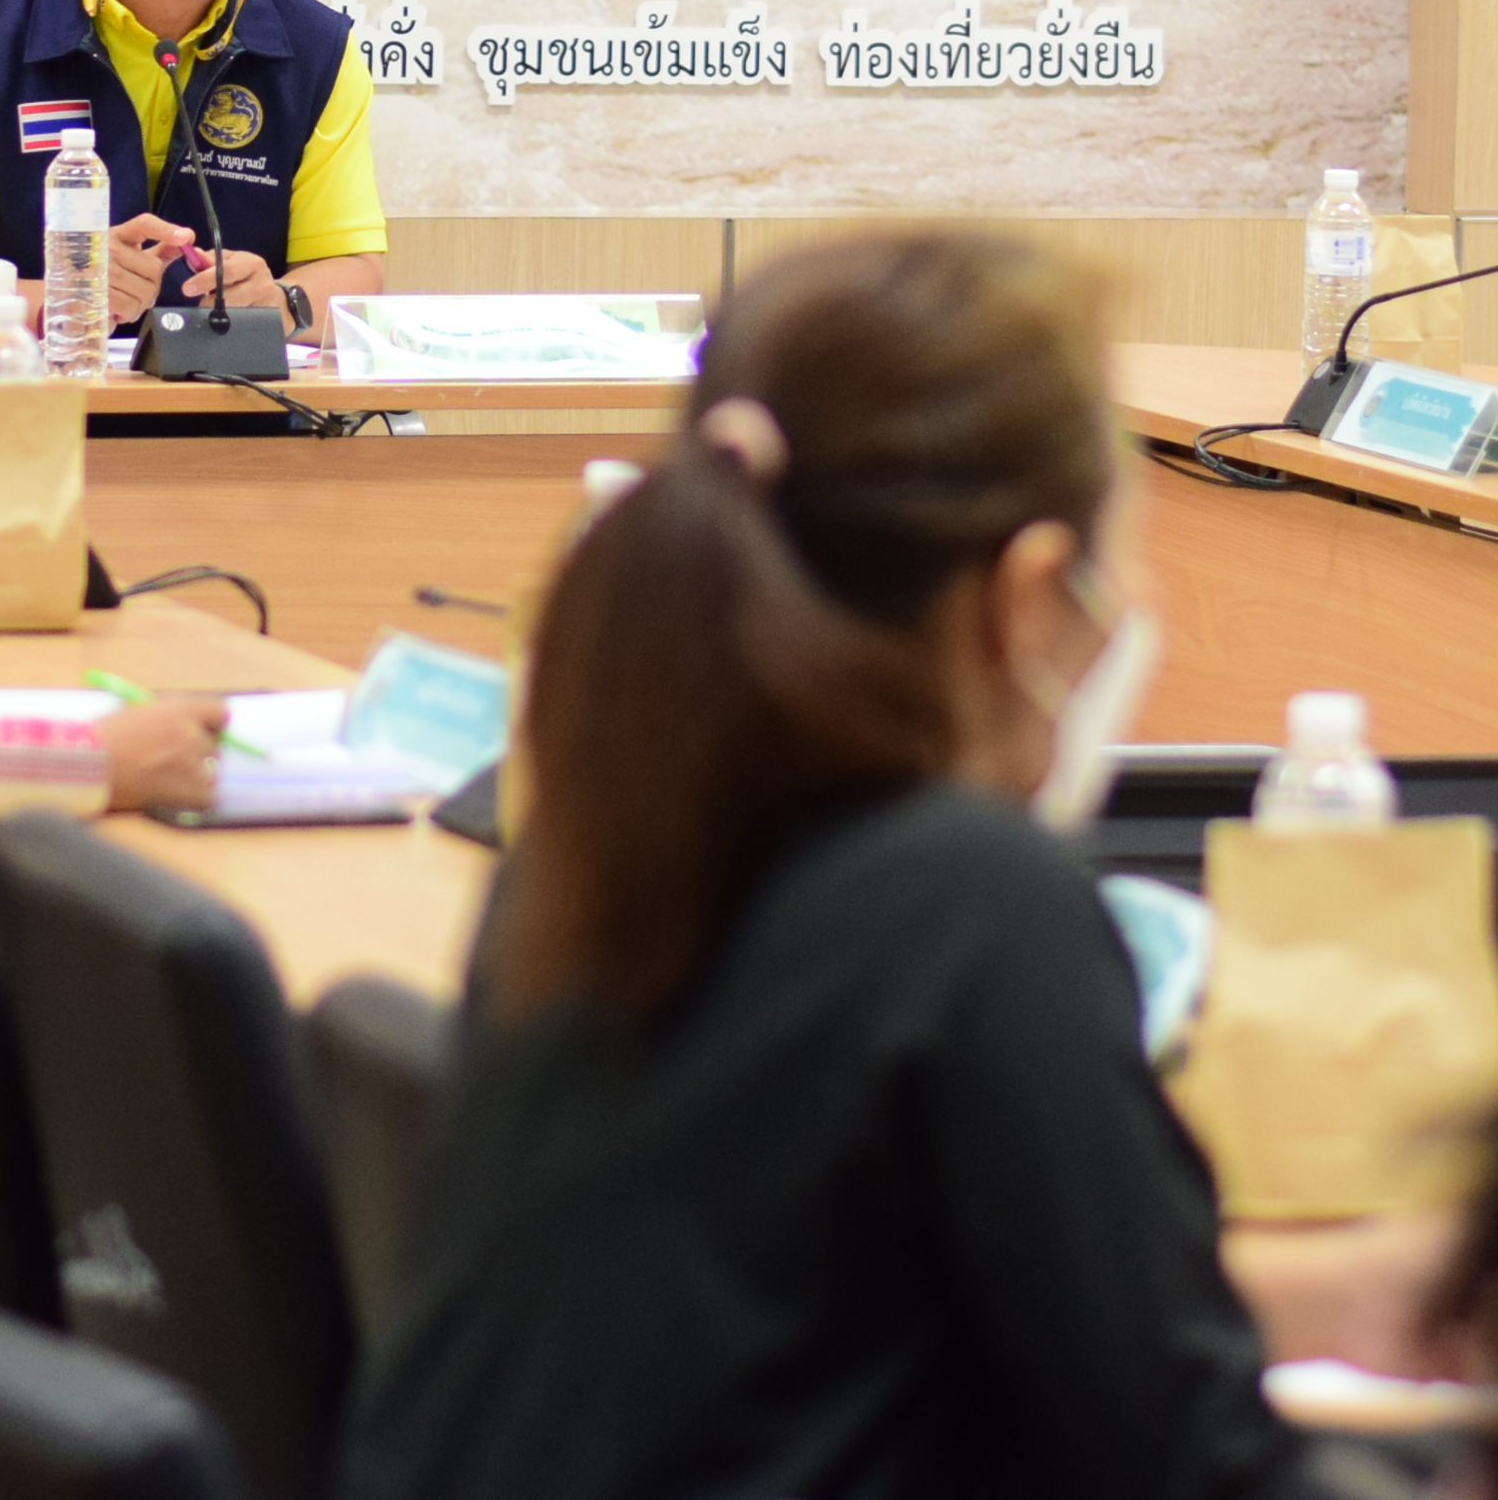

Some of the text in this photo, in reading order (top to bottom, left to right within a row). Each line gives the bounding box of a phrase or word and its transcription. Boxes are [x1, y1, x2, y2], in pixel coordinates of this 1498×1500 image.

[478, 13, 787, 96] ชุมชนเข้มแข็ง
[828, 8, 1155, 80] ท่องเที่ยวยั่งยืน
